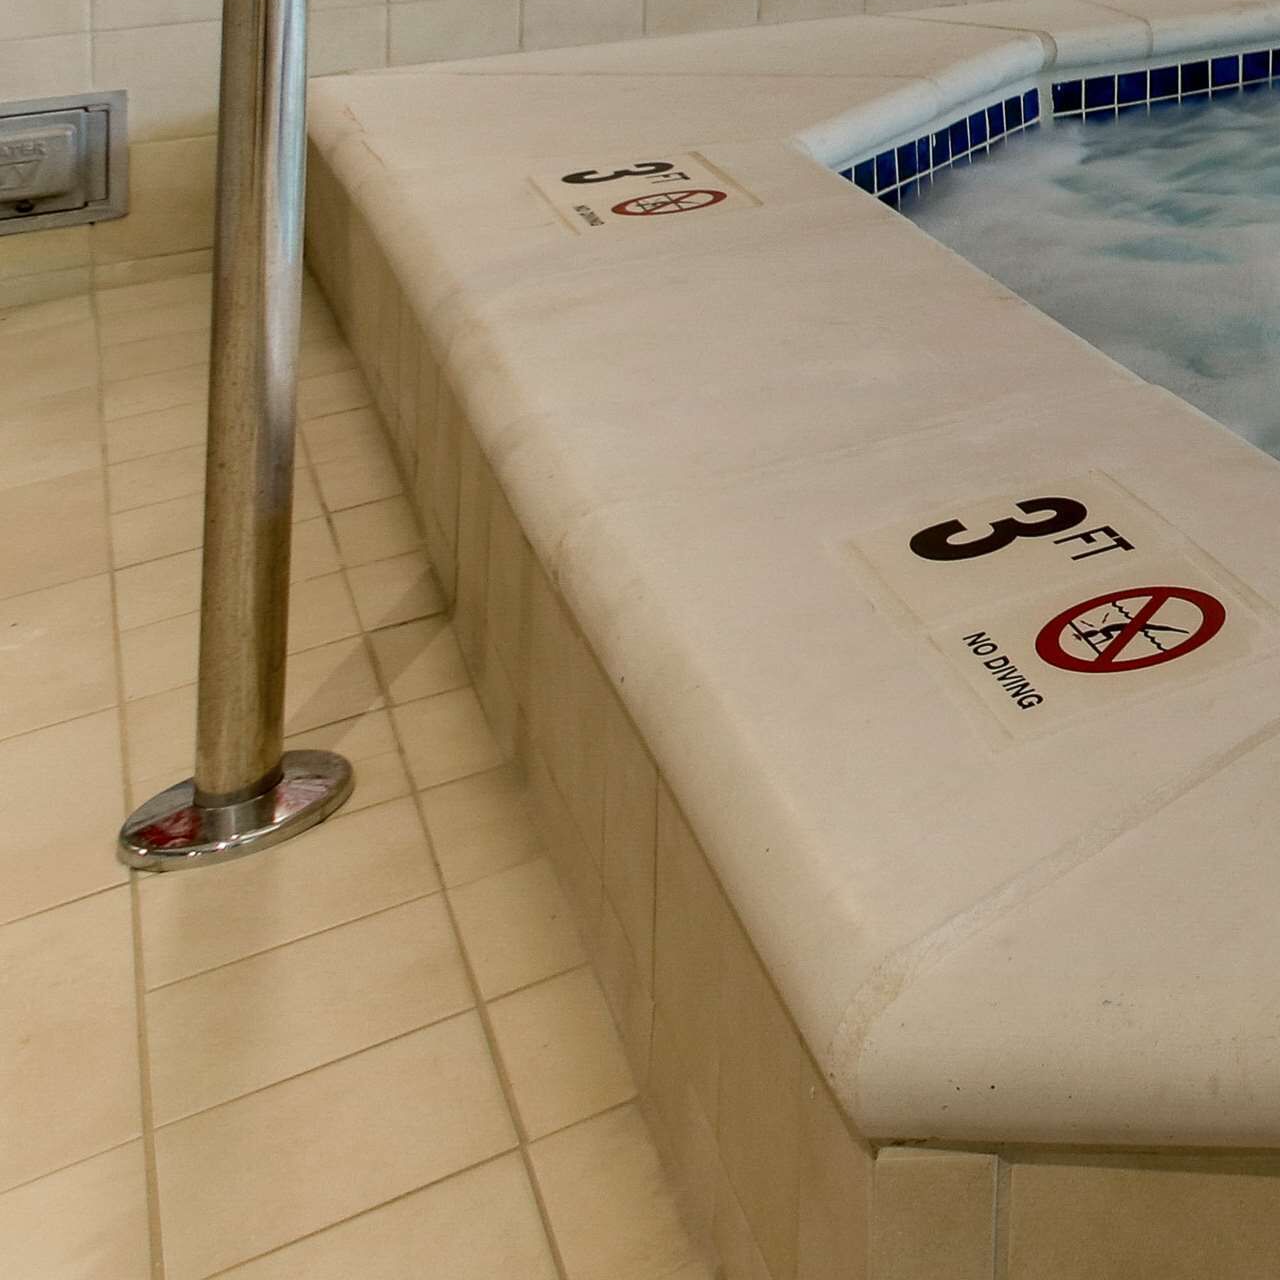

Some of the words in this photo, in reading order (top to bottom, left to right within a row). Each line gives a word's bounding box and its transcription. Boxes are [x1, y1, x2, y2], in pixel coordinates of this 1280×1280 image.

[561, 161, 674, 185] 3
[909, 496, 1088, 562] 3
[1053, 525, 1136, 562] FT
[962, 631, 999, 657] NO
[983, 656, 1044, 711] DIVING
